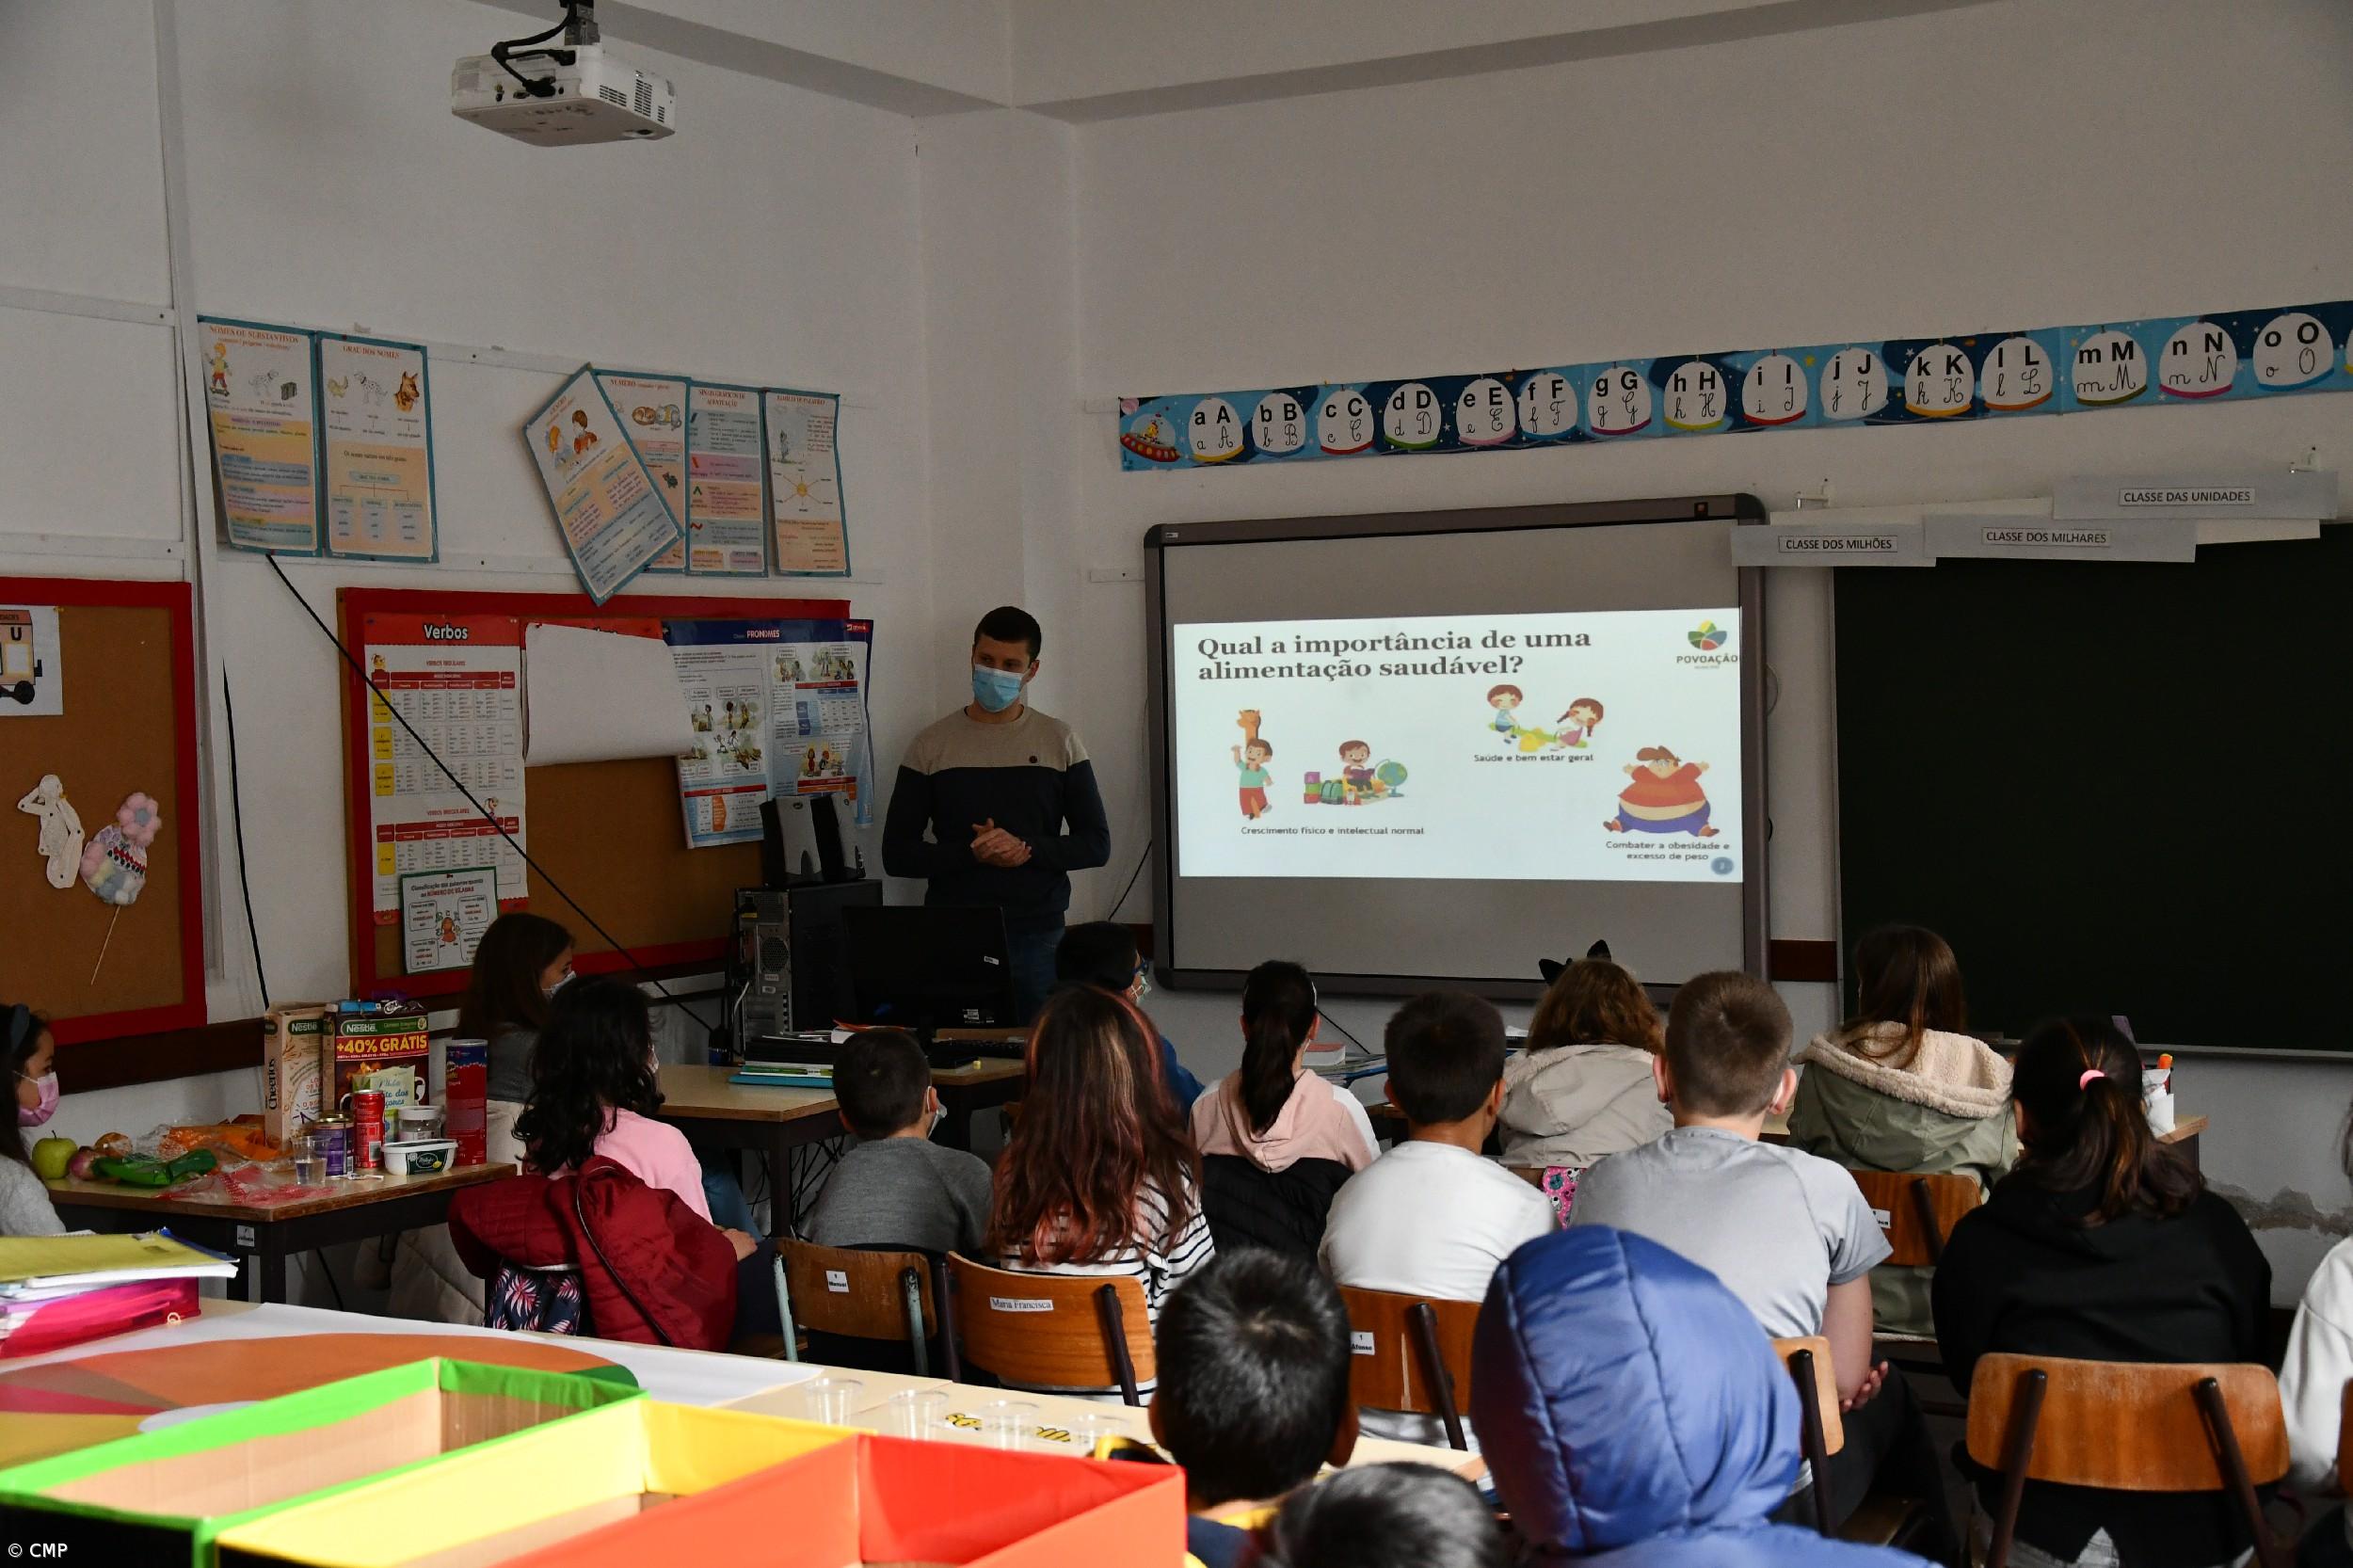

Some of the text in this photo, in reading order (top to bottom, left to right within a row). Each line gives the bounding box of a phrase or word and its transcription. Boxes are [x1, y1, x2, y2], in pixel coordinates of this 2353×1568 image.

[2173, 332, 2222, 355] n N
[2265, 322, 2319, 346] o O
[2025, 345, 2040, 365] L
[2079, 341, 2134, 363] m M
[1833, 355, 1870, 379] j J
[1917, 355, 1962, 376] k K
[1595, 371, 1638, 396] g G
[1674, 372, 1715, 392] h H
[1757, 367, 1762, 385] i
[1464, 387, 1502, 407] e E
[1529, 380, 1563, 400] f F
[1326, 398, 1362, 418] c C
[1393, 391, 1431, 410] d D
[1195, 406, 1230, 424] a A
[1260, 404, 1297, 422] b B
[2123, 490, 2251, 503] CLASSE DAS UNIDADES
[1785, 537, 1892, 550] CLASSE DOS MILHÕES
[1986, 531, 2106, 544] CLASSE DOS MILHARES
[10, 627, 23, 640] U
[424, 623, 469, 640] Verbos
[1198, 630, 1591, 659] Qual a importância de uma
[1199, 655, 1523, 681] alimentação saudável?
[1676, 653, 1738, 664] POVOAÇÃO
[1568, 754, 1593, 762] geral
[1241, 826, 1299, 835] Crescimento
[1301, 826, 1325, 835] físico
[1337, 826, 1388, 835] intelectual
[1685, 853, 1709, 862] peso
[346, 1023, 376, 1033] Nestlé
[337, 1033, 427, 1053] +40% GRÁTIS
[992, 1299, 1013, 1308] Maria
